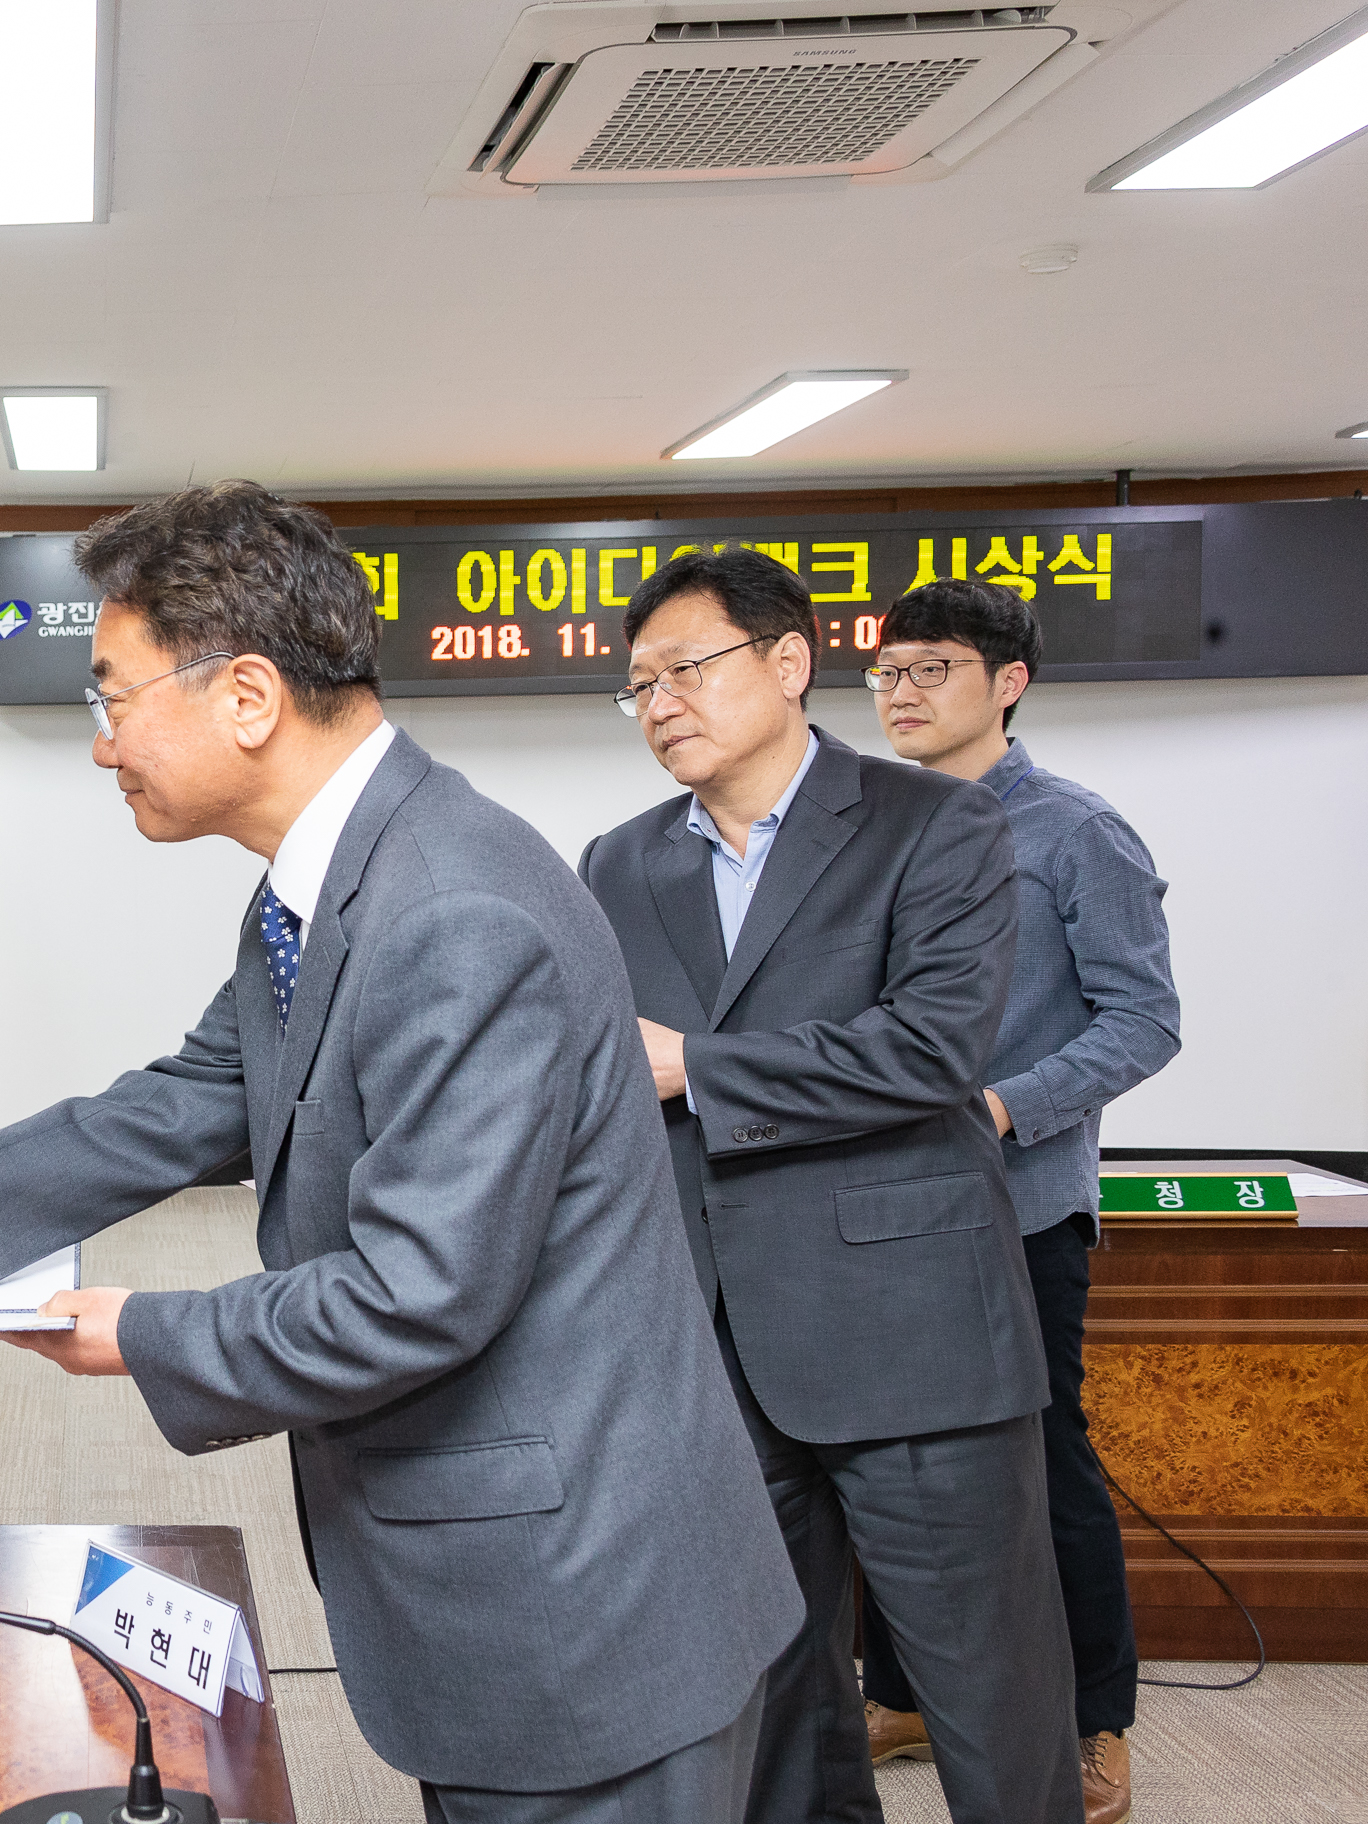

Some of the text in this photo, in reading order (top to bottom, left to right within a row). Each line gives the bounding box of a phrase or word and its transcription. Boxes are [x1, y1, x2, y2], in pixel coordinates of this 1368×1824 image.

[792, 48, 857, 57] SAMSUNG
[456, 541, 872, 616] 아이디크
[901, 533, 1114, 603] 시상식
[36, 601, 103, 625] 광진
[37, 625, 96, 637] GWANGJI
[430, 614, 887, 661] 2018. 11. :0
[113, 1608, 212, 1690] 박현대
